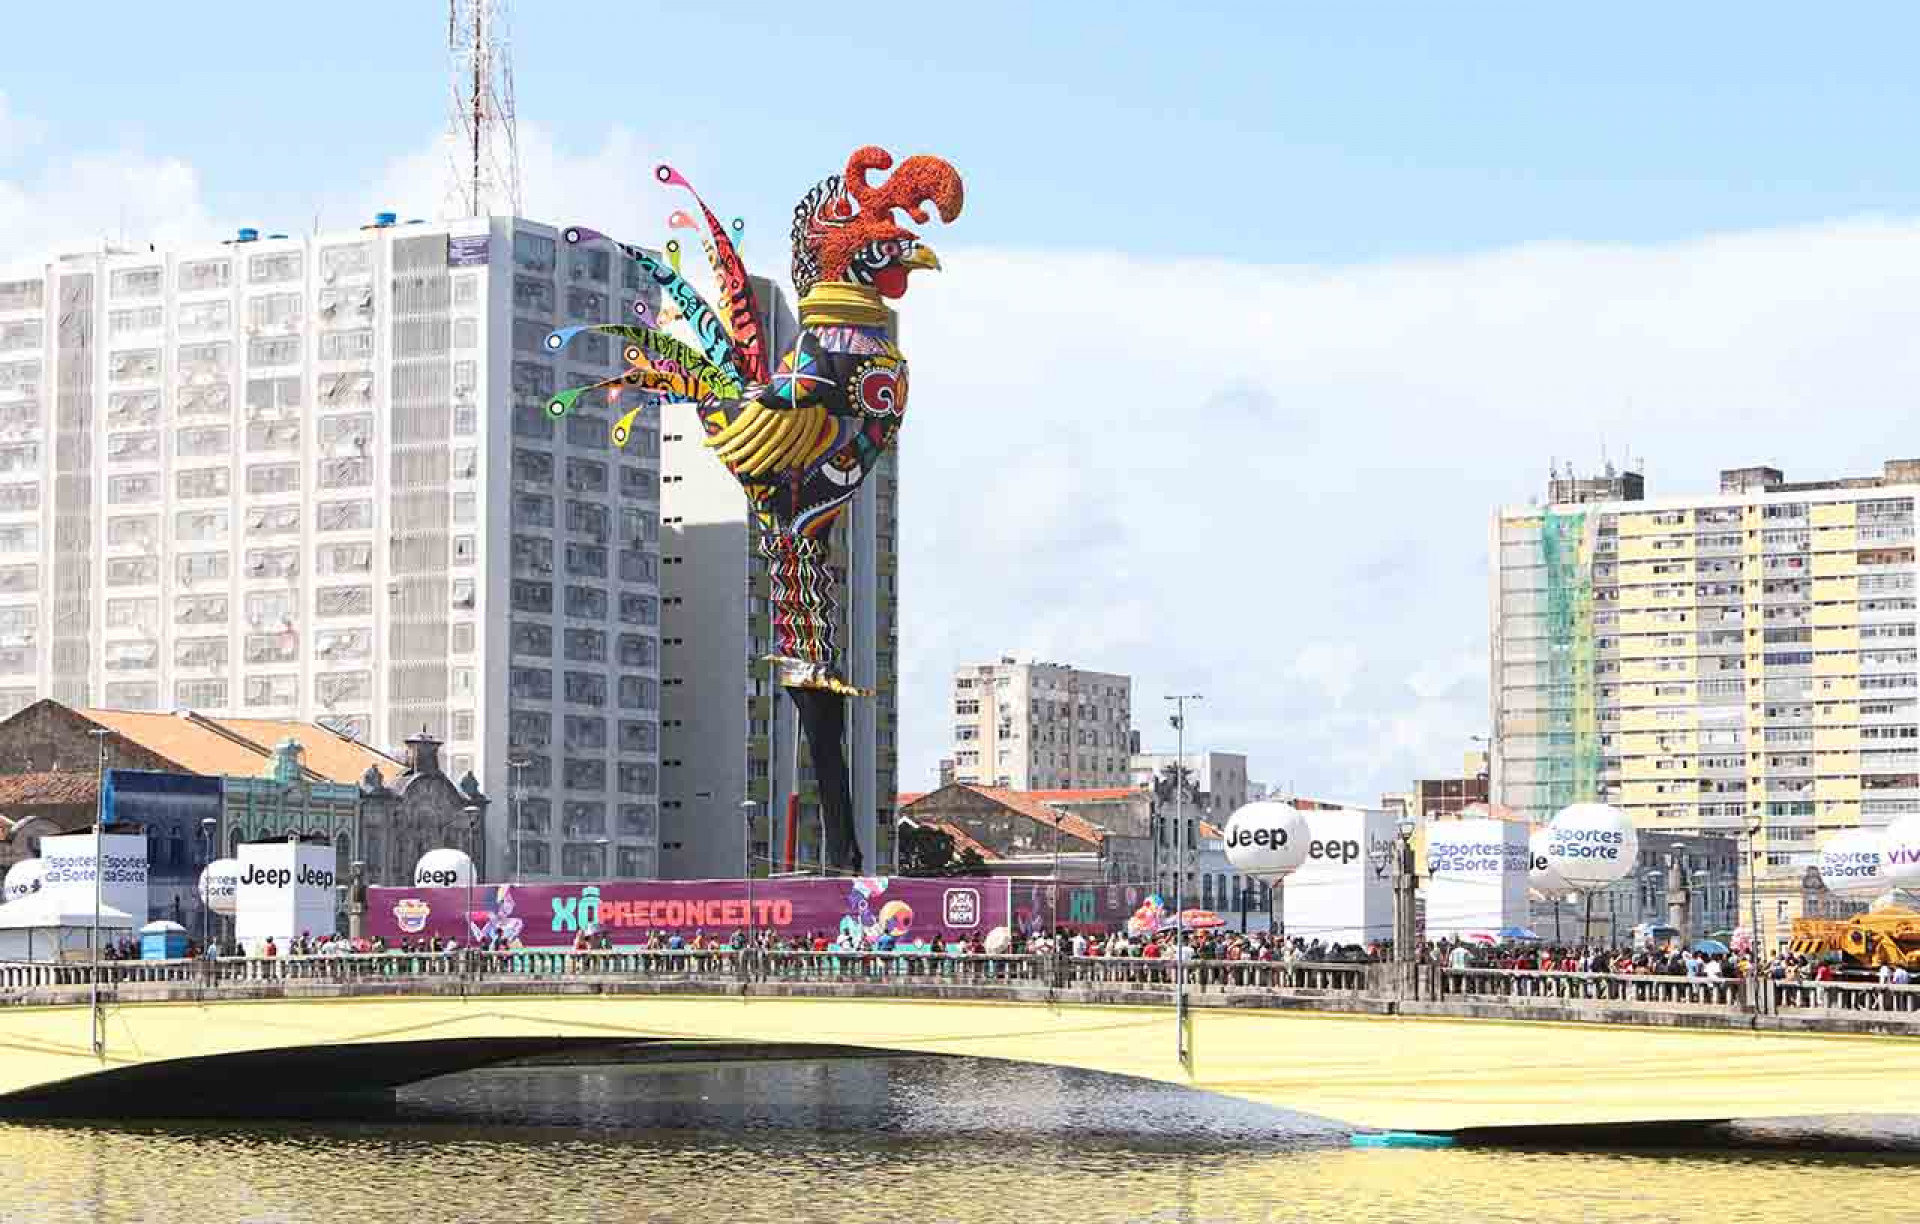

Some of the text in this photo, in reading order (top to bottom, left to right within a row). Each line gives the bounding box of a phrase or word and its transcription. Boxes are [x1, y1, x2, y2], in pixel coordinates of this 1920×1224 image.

[1227, 825, 1288, 850] Jeep
[1551, 828, 1623, 844] sportes
[1308, 840, 1360, 864] eep
[1529, 851, 1549, 871] Je
[1823, 851, 1880, 864] sportes
[1888, 843, 1920, 865] viv
[240, 864, 291, 888] Jeep
[297, 864, 333, 891] Jeep
[416, 868, 457, 886] Jeep
[600, 899, 793, 927] PRECONCEITO
